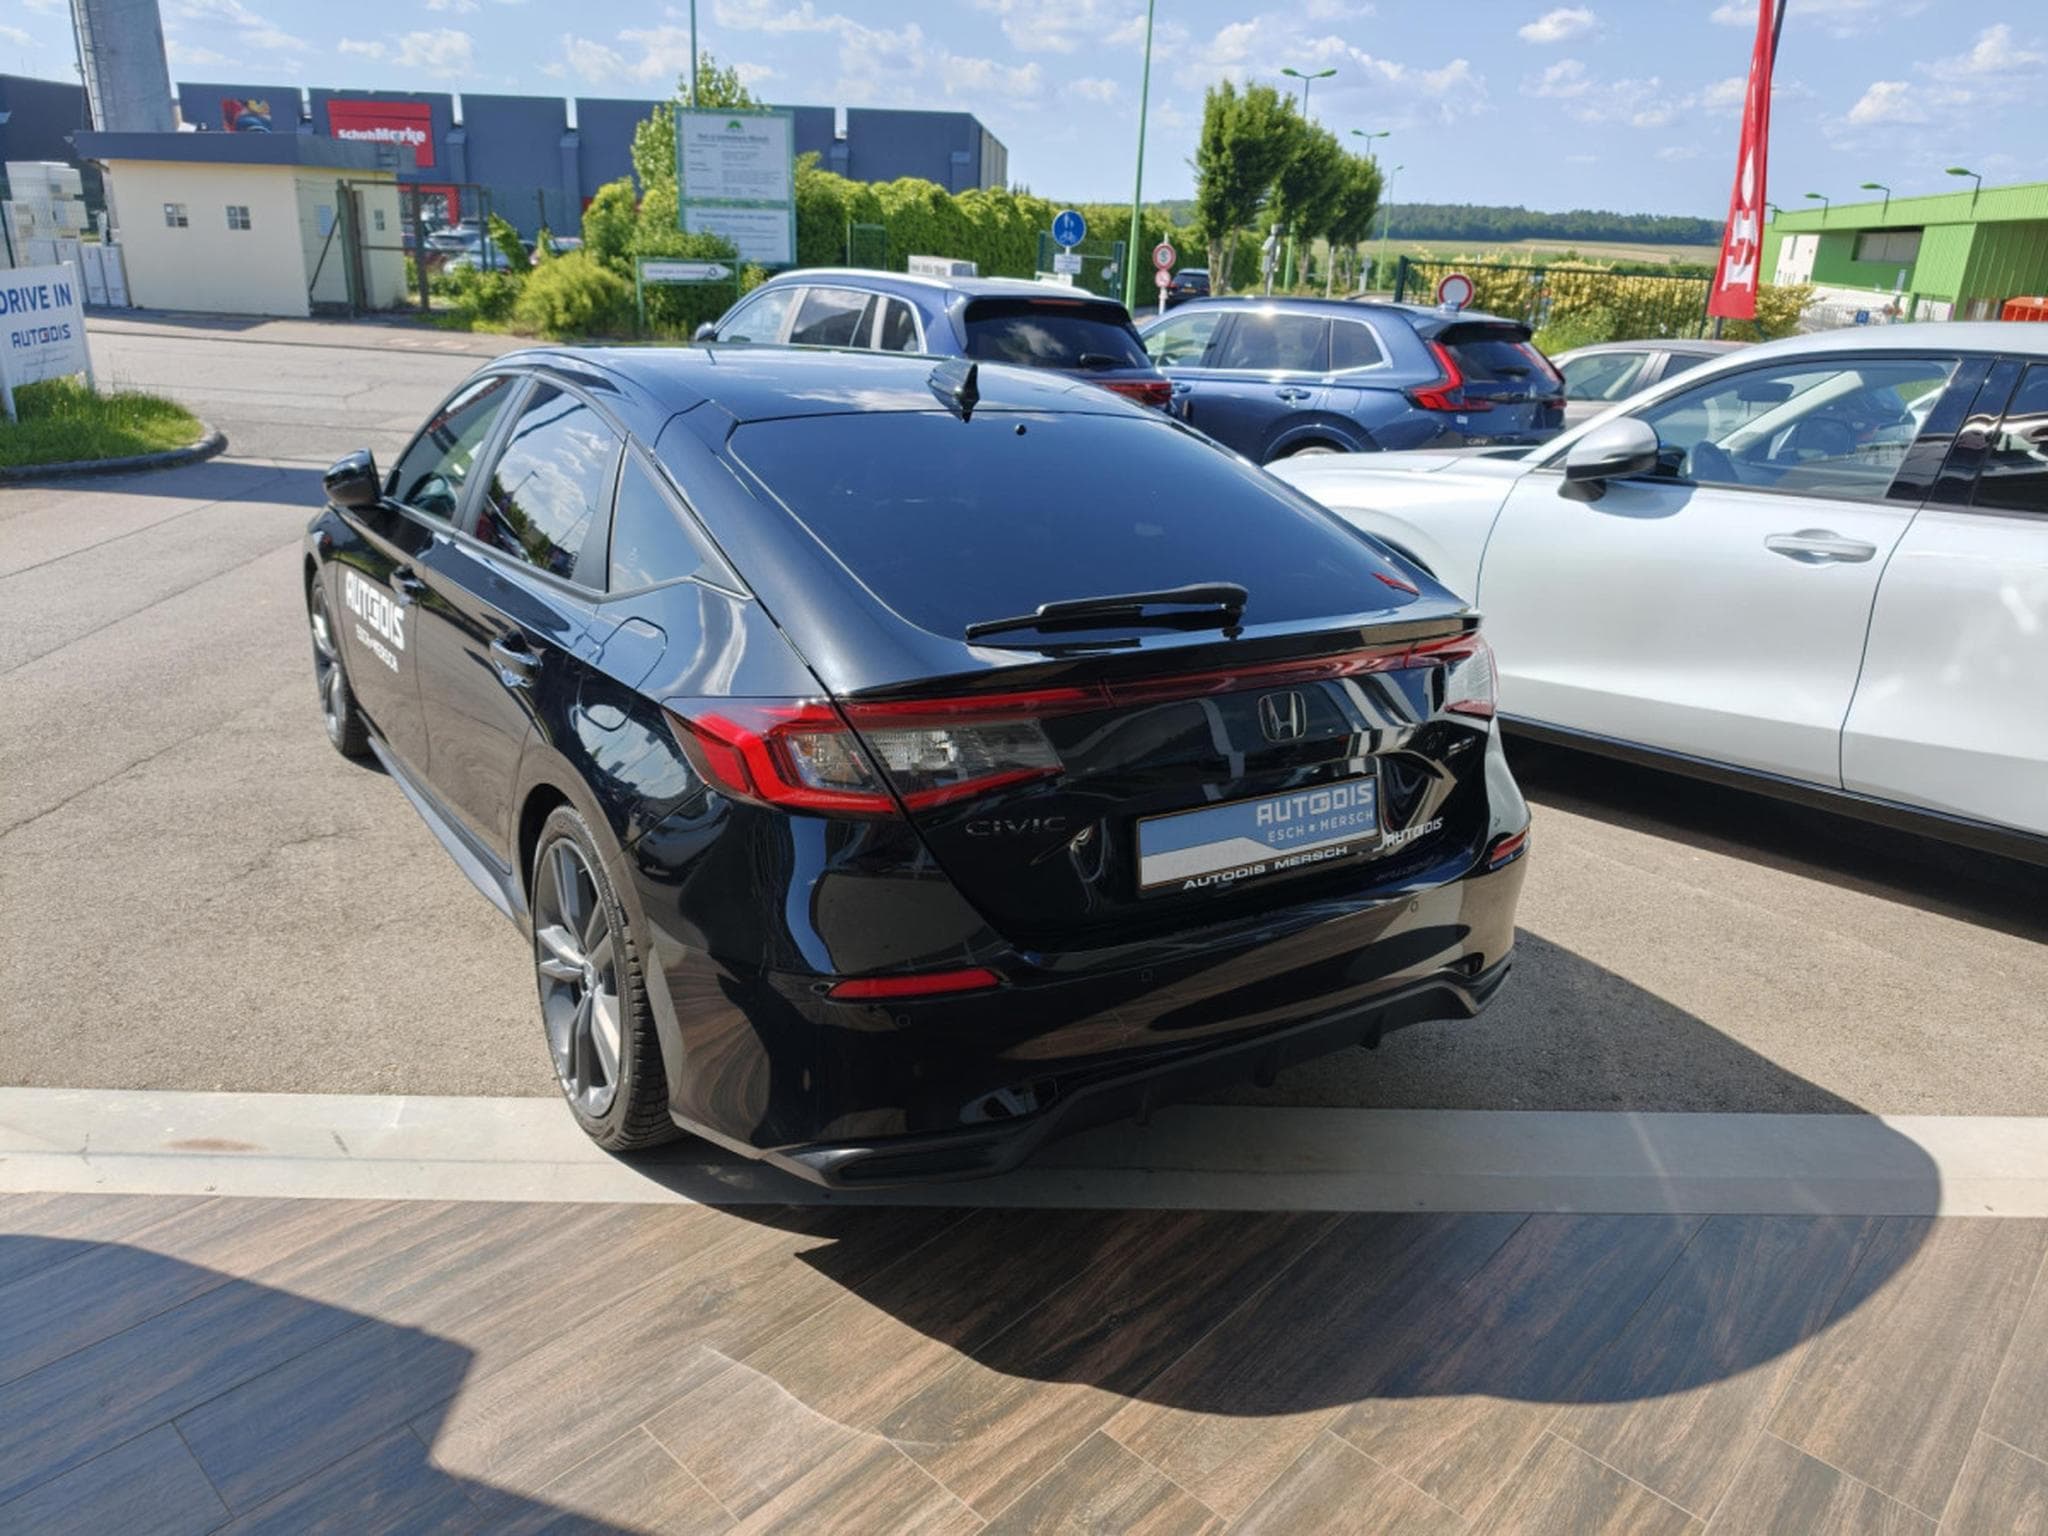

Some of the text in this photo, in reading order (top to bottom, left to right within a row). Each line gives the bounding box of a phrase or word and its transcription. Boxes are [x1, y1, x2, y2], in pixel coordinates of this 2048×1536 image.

[0, 283, 72, 315] DRIVE IN
[11, 324, 71, 348] AUTODIS
[1257, 783, 1373, 826] AUTODIS
[966, 816, 1066, 836] CIVIC
[1268, 809, 1373, 842] ESCH MERSCH
[1183, 864, 1266, 890] AUTODIS
[1274, 846, 1348, 870] MERSCH
